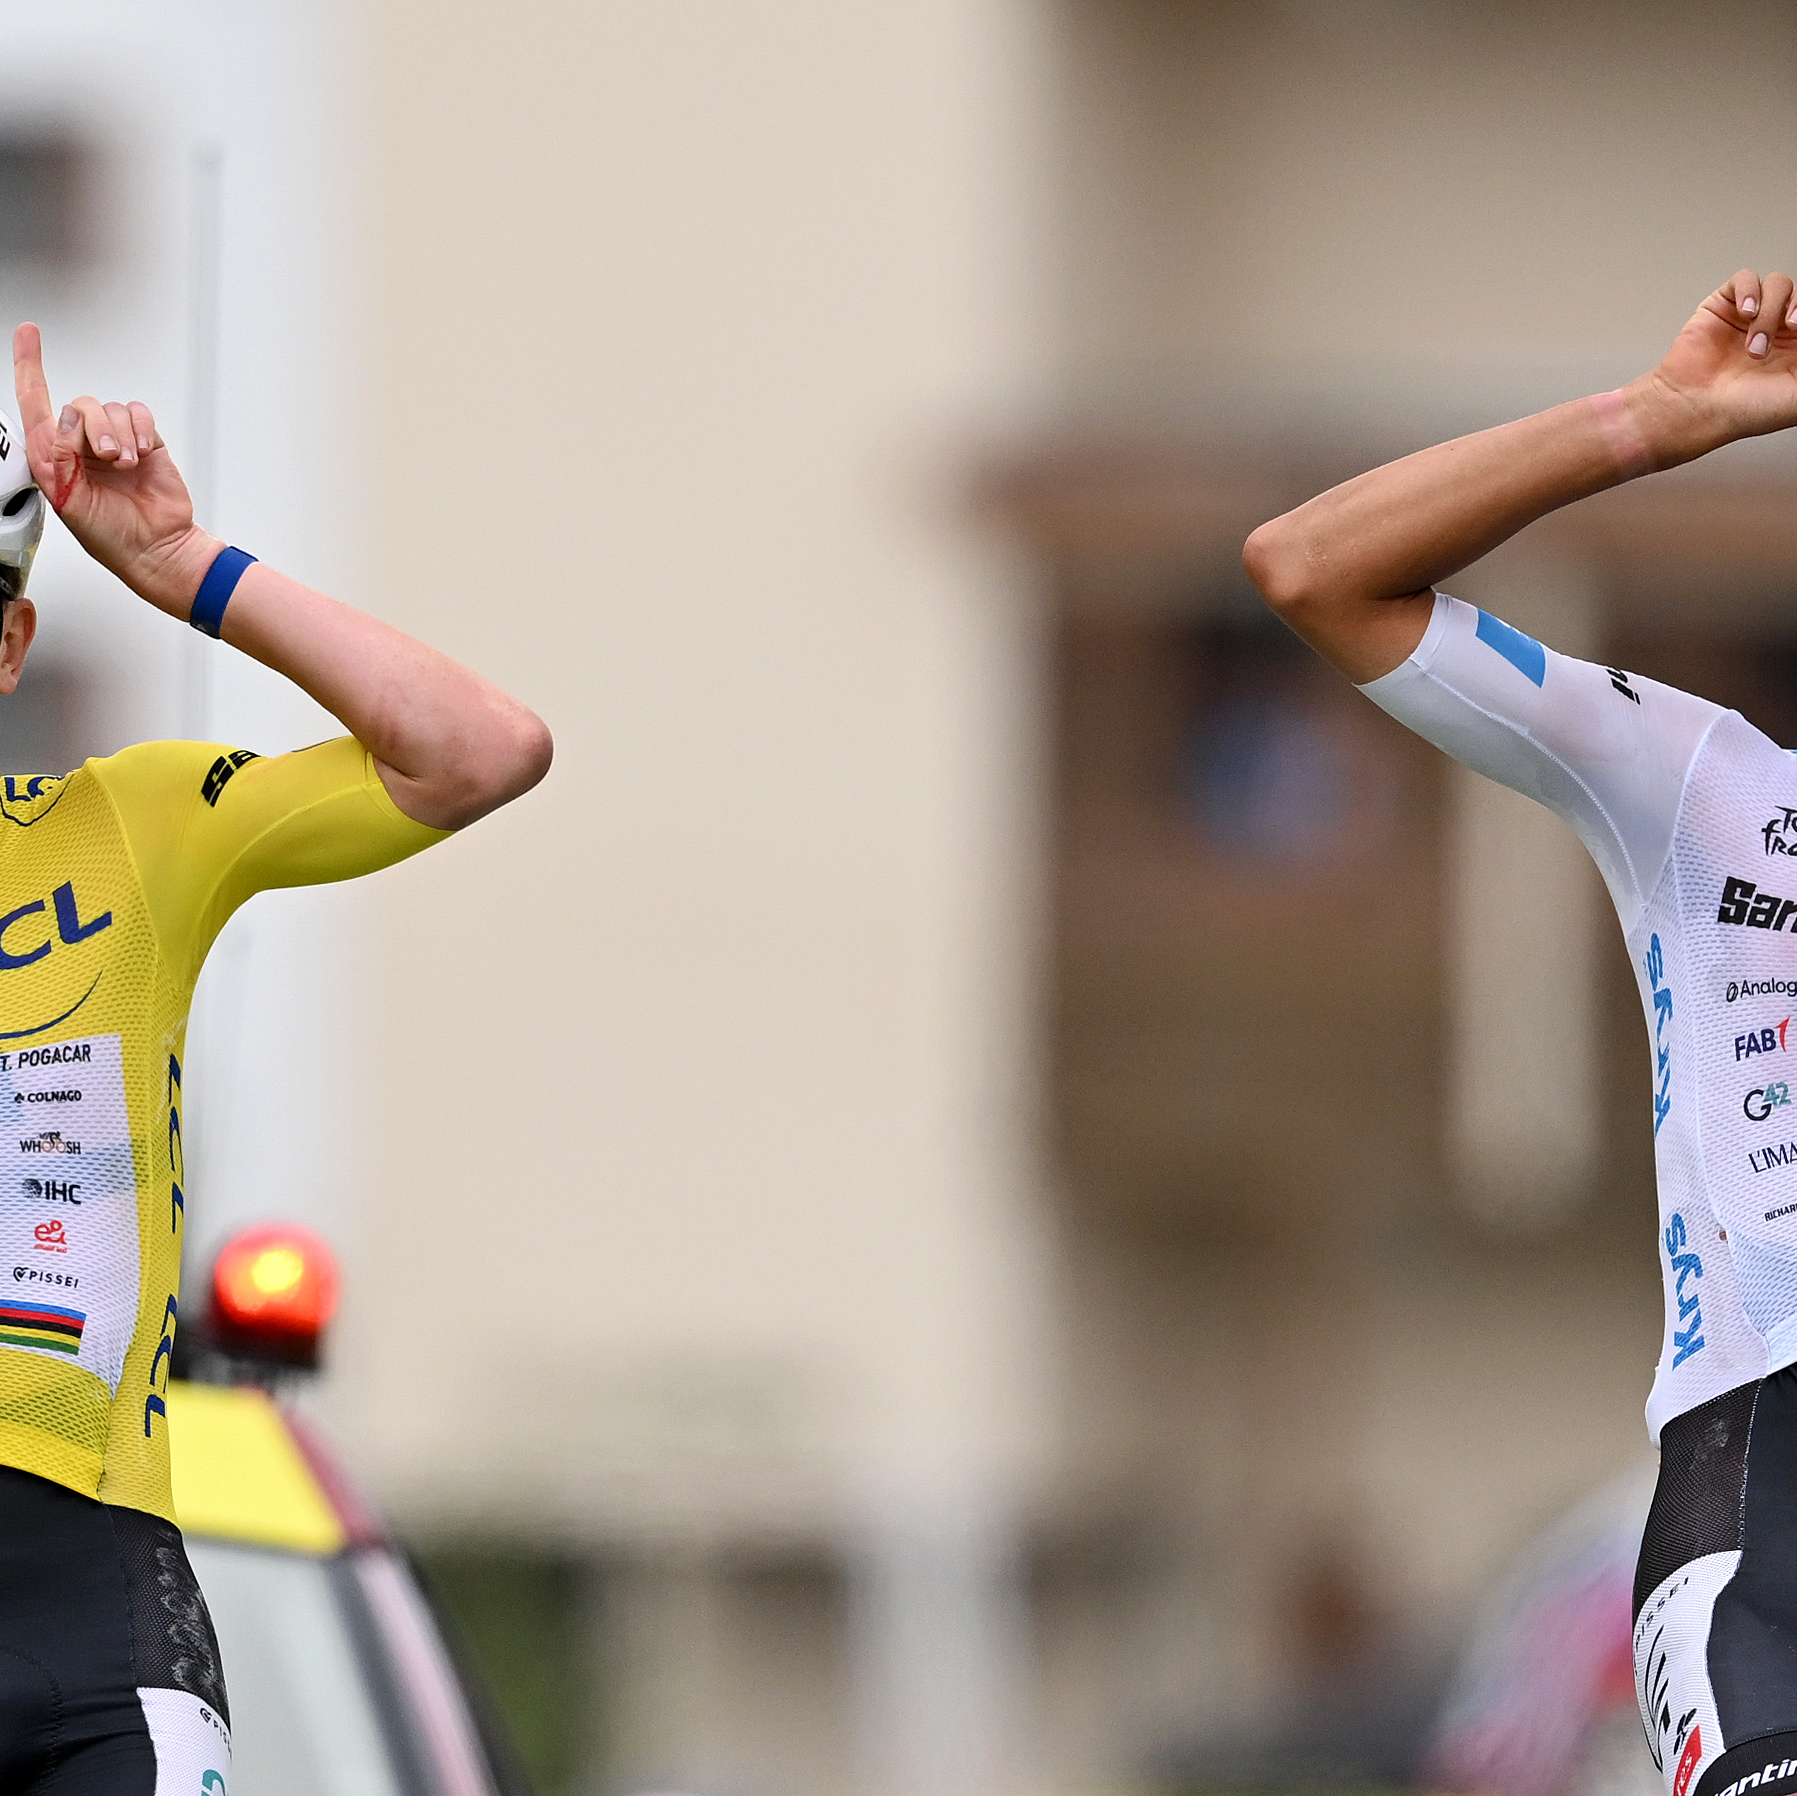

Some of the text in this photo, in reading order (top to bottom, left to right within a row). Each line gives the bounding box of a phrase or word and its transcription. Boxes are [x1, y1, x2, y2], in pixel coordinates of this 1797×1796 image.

[0, 1043, 92, 1072] T. POGACAR
[26, 1089, 83, 1104] COLNAGO
[1743, 1081, 1793, 1122] G42
[44, 1180, 82, 1206] IHC
[28, 1269, 80, 1289] PISSEI
[1664, 1212, 1705, 1372] Krys
